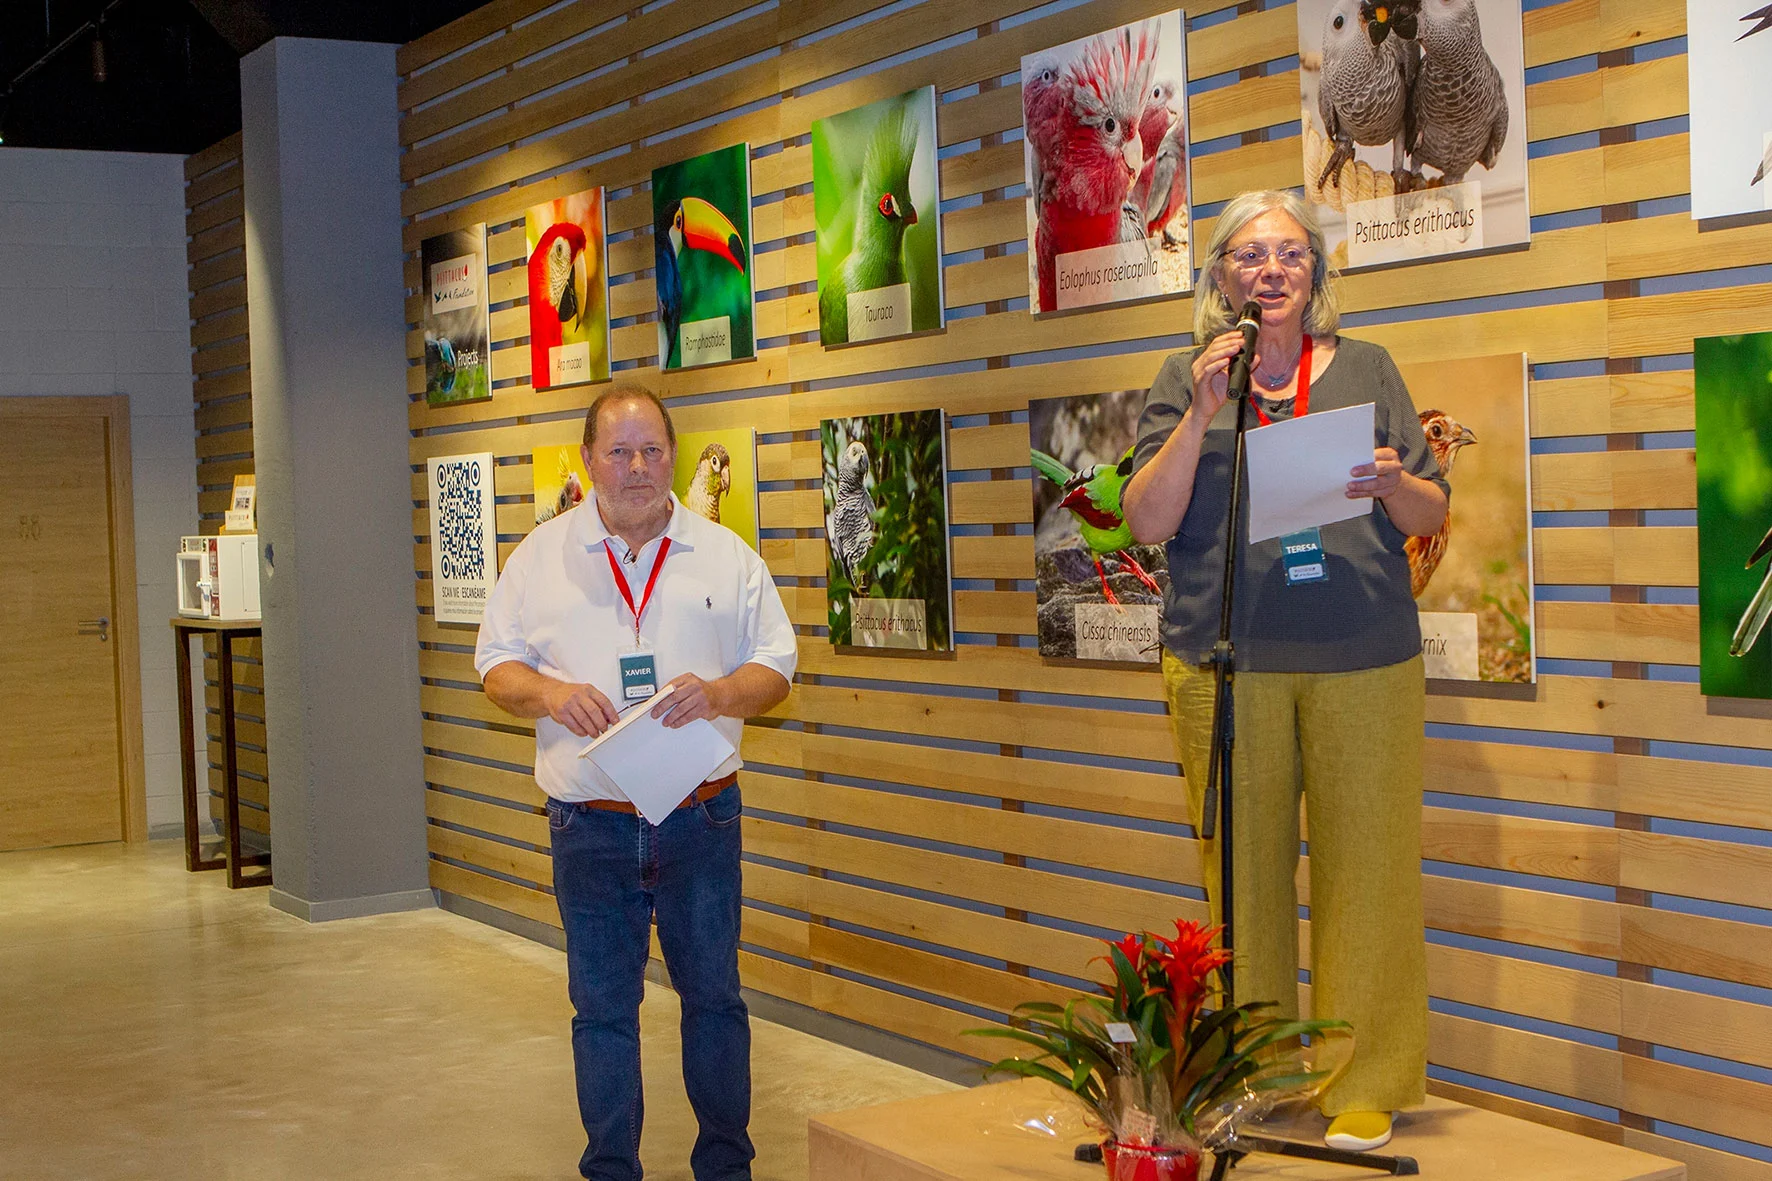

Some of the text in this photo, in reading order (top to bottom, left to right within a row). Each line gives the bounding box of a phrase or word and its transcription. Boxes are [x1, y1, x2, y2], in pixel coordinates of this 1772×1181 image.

[1355, 207, 1475, 243] Psittacus erithacus
[1060, 255, 1158, 292] Eolophus roseicapilla
[865, 305, 894, 322] Touraco
[686, 331, 727, 352] Ramphastidae
[457, 348, 479, 369] Projects
[1285, 543, 1318, 554] TERESA
[441, 586, 453, 598] SCAN
[855, 612, 922, 632] Psittacus erithacus
[1082, 620, 1152, 642] Cissa chinensis
[625, 667, 652, 677] XAVIER
